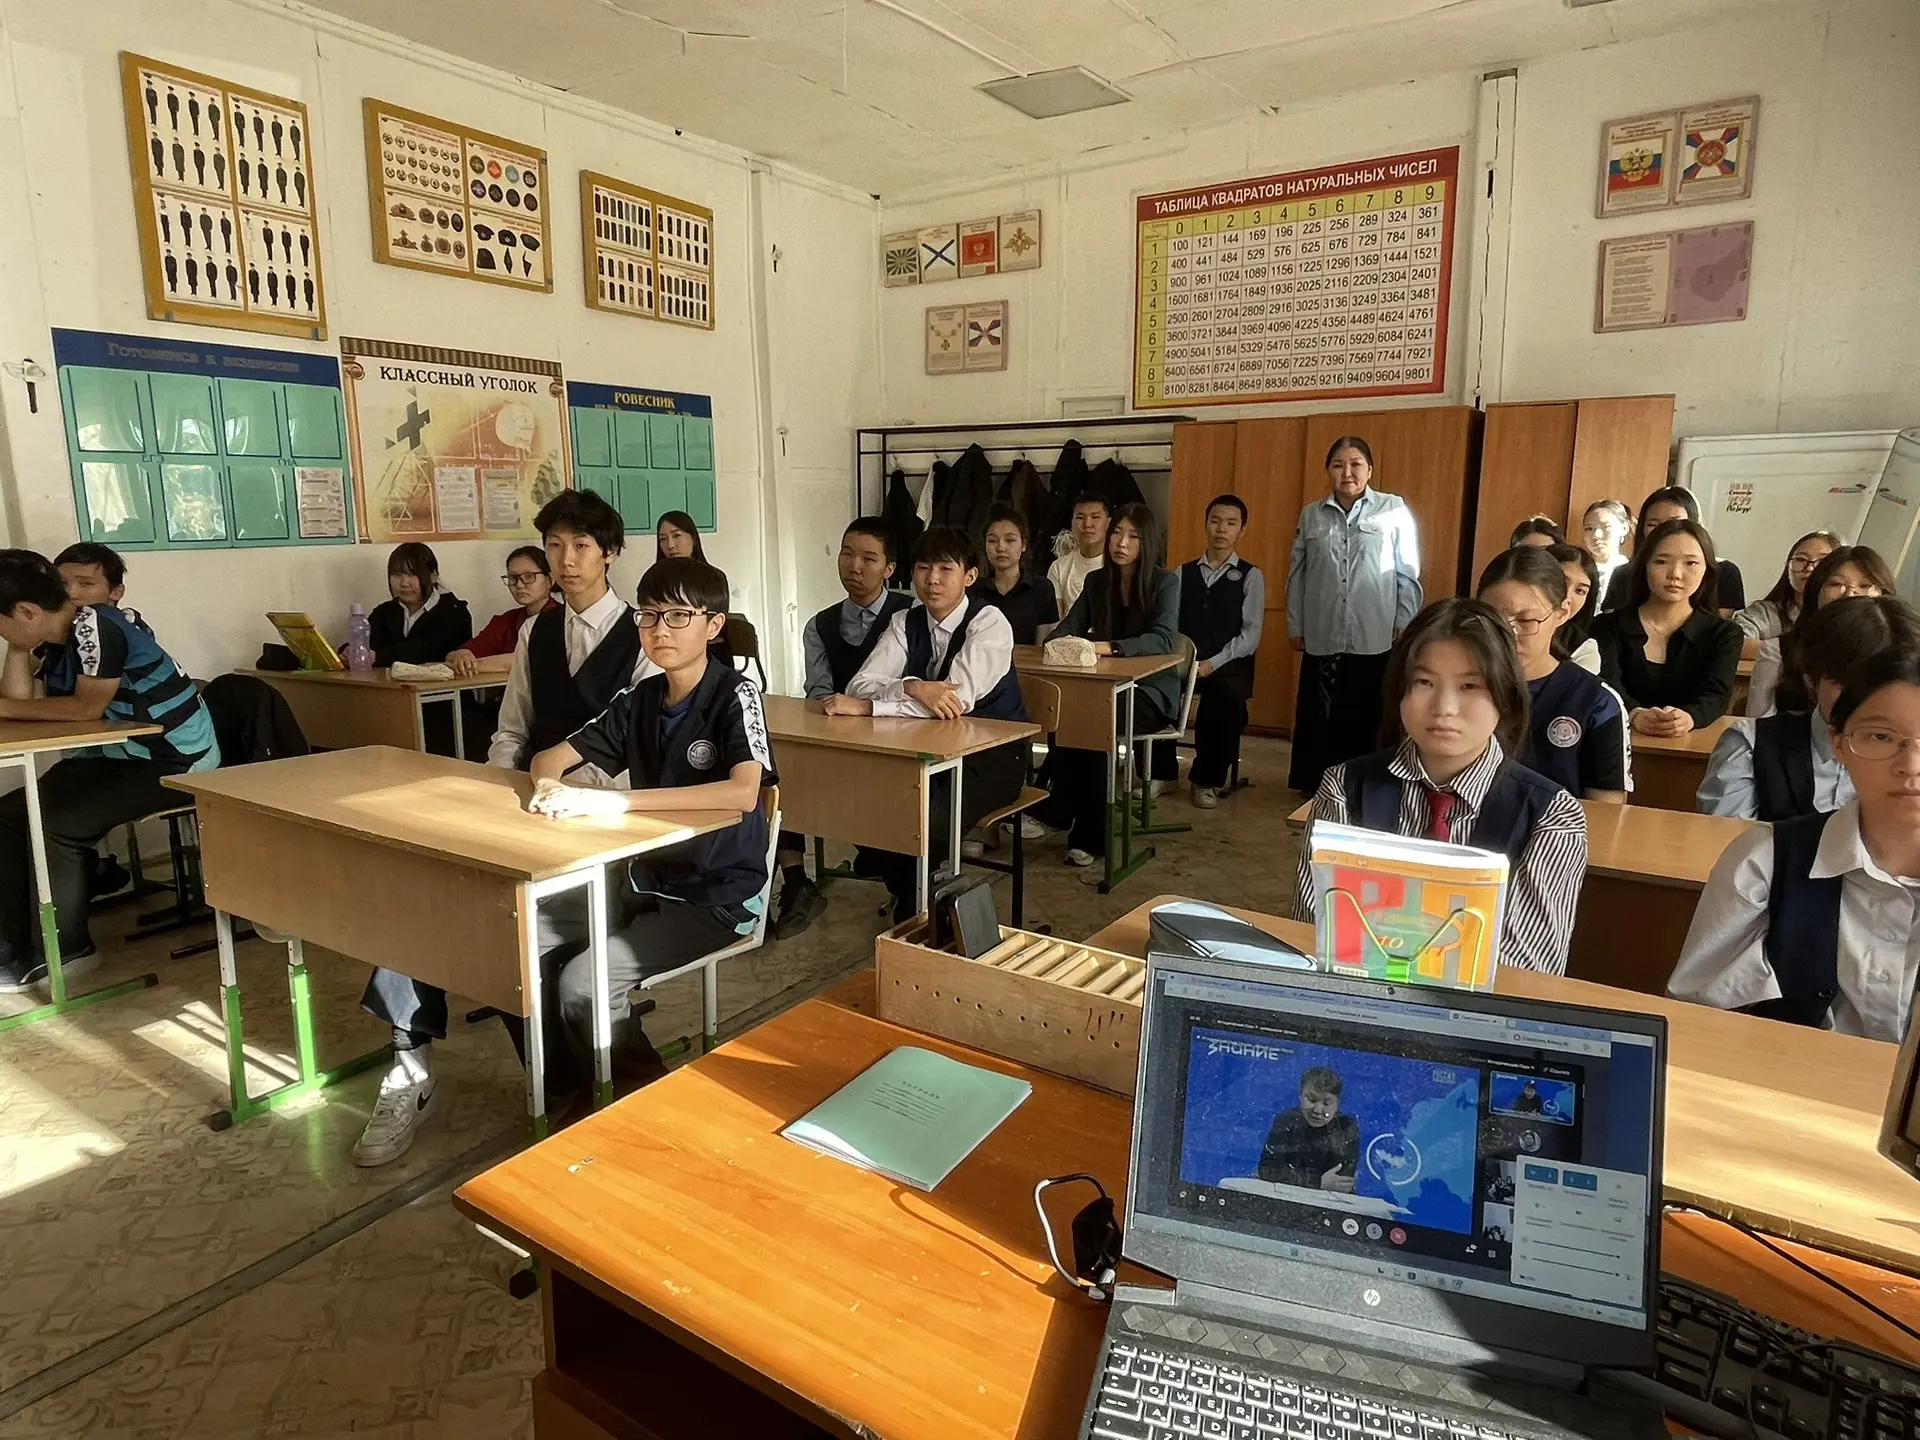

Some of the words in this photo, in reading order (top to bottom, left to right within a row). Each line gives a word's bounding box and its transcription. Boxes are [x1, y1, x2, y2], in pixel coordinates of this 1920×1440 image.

[1155, 194, 1209, 214] ТАБЛИЦА
[1211, 183, 1284, 207] КВАДРАТОВ
[1286, 166, 1386, 195] НАТУРАЛЬНЫХ
[1389, 158, 1438, 178] ЧИСЕЛ
[1152, 242, 1157, 255] 1
[1172, 239, 1189, 251] 100
[1197, 236, 1212, 248] 121
[1223, 233, 1239, 244] 144
[1248, 228, 1266, 241] 169
[1275, 225, 1293, 238] 196
[1302, 221, 1321, 235] 225
[1329, 217, 1349, 231] 256
[1359, 213, 1378, 227] 289
[1387, 210, 1407, 223] 324
[1418, 206, 1437, 219] 361
[1176, 221, 1184, 235] 0
[1203, 218, 1208, 231] 1
[1226, 214, 1234, 228] 2
[1253, 210, 1261, 225] 3
[1280, 206, 1288, 220] 4
[1308, 202, 1317, 217] 5
[1335, 198, 1344, 213] 6
[1366, 194, 1374, 208] 7
[1394, 189, 1403, 205] 8
[1425, 185, 1434, 201] 9
[1150, 260, 1158, 274] 2
[1171, 257, 1187, 269] 400
[1195, 255, 1212, 266] 441
[1220, 252, 1238, 264] 484
[1247, 248, 1265, 260] 529
[1274, 244, 1292, 257] 576
[1301, 240, 1321, 254] 625
[1329, 237, 1348, 251] 676
[1358, 233, 1377, 246] 729
[1386, 230, 1405, 243] 784
[1416, 226, 1436, 240] 841
[1150, 279, 1158, 292] 3
[1170, 276, 1187, 288] 900
[1194, 273, 1211, 285] 961
[1218, 270, 1240, 282] 1024
[1244, 266, 1267, 279] 1089
[1271, 263, 1293, 276] 1156
[1298, 260, 1322, 273] 1225
[1326, 256, 1350, 270] 1296
[1354, 253, 1380, 267] 1369
[1383, 250, 1408, 263] 1444
[1414, 246, 1437, 260] 1521
[1149, 297, 1157, 310] 4
[1168, 293, 1189, 306] 1600
[1193, 291, 1213, 303] 1681
[1217, 288, 1239, 300] 1764
[1244, 285, 1266, 298] 1849
[1270, 282, 1293, 295] 1936
[1296, 279, 1321, 292] 2025
[1324, 276, 1349, 289] 2116
[1352, 273, 1379, 286] 2209
[1381, 270, 1407, 283] 2304
[1411, 267, 1436, 280] 2401
[1149, 314, 1157, 328] 5
[1167, 312, 1188, 325] 2500
[1191, 310, 1212, 322] 2601
[1215, 307, 1239, 320] 2704
[1241, 304, 1266, 317] 2809
[1268, 302, 1292, 314] 2916
[1296, 298, 1320, 312] 3025
[1322, 296, 1348, 309] 3136
[1351, 293, 1377, 307] 3249
[1380, 290, 1405, 304] 3364
[1410, 287, 1435, 301] 3481
[1148, 332, 1157, 346] 6
[1166, 330, 1188, 342] 3600
[1191, 328, 1212, 340] 3721
[1215, 326, 1237, 338] 3844
[1240, 322, 1265, 336] 3969
[1267, 320, 1291, 332] 4096
[1294, 318, 1319, 330] 4225
[1321, 315, 1347, 328] 4356
[1350, 312, 1375, 325] 4489
[1378, 310, 1404, 323] 4624
[1408, 307, 1433, 320] 4761
[1148, 350, 1156, 363] 7
[1165, 348, 1188, 359] 4900
[1189, 346, 1211, 358] 5041
[1215, 344, 1237, 356] 5184
[1240, 341, 1263, 354] 5329
[1266, 339, 1290, 351] 5476
[1293, 336, 1318, 350] 5625
[1320, 334, 1346, 347] 5776
[1349, 332, 1375, 345] 5929
[1377, 330, 1403, 343] 6084
[1407, 327, 1432, 340] 6241
[379, 365, 476, 388] КЛАССНЫЙ
[480, 375, 539, 395] УГОЛОК
[1147, 367, 1155, 381] 8
[1164, 365, 1186, 377] 6400
[1189, 364, 1210, 375] 6561
[1213, 362, 1235, 374] 6724
[1239, 359, 1262, 372] 6889
[1266, 358, 1290, 370] 7056
[1293, 355, 1318, 368] 7225
[1320, 353, 1345, 366] 7396
[1348, 351, 1374, 364] 7569
[1377, 349, 1402, 362] 7744
[1407, 347, 1431, 359] 7921
[1147, 385, 1155, 398] 9
[1164, 383, 1186, 395] 8100
[1188, 382, 1209, 394] 8281
[1212, 380, 1235, 392] 8464
[1238, 378, 1262, 391] 8649
[1264, 376, 1288, 389] 8836
[1291, 375, 1317, 387] 9025
[1319, 373, 1343, 385] 9216
[1346, 371, 1373, 384] 9409
[1375, 369, 1401, 382] 9604
[1405, 367, 1430, 380] 9801
[614, 391, 676, 409] РОВЕСНИК
